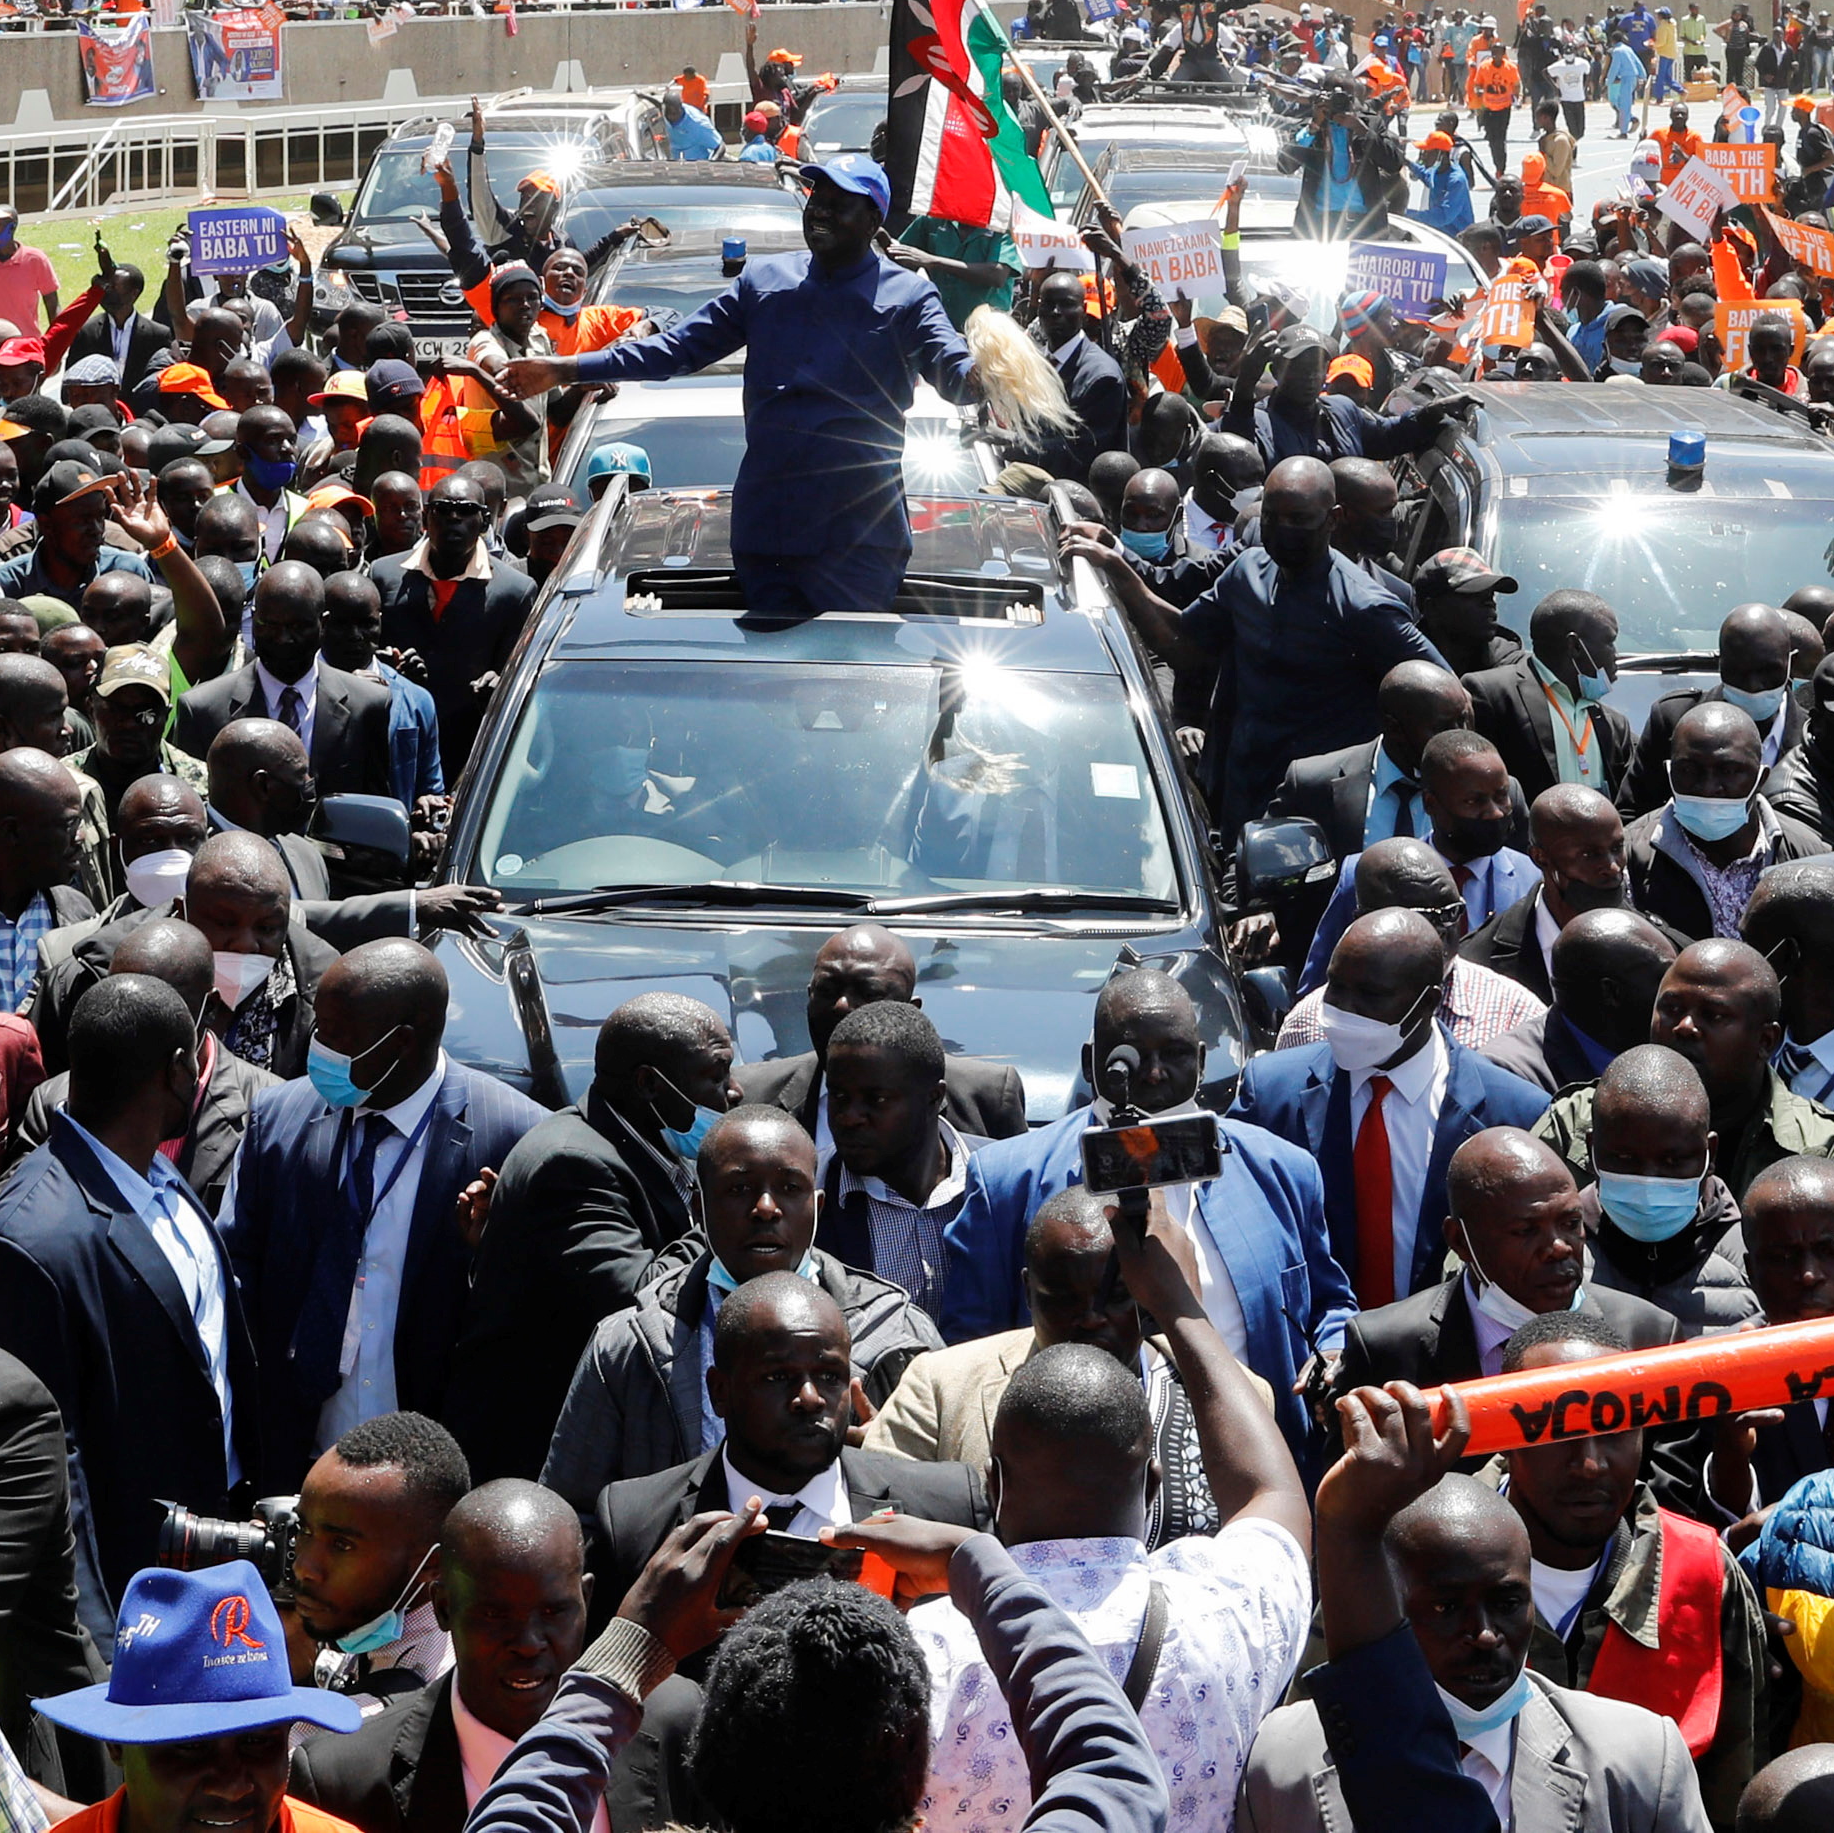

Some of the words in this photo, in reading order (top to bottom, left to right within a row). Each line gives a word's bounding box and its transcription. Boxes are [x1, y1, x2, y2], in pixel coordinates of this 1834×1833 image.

[1705, 149, 1735, 165] BABA
[1739, 150, 1764, 166] THE
[199, 218, 259, 239] EASTERN
[262, 217, 275, 234] NI
[1803, 229, 1826, 249] THE
[200, 236, 251, 261] BABA
[253, 234, 277, 256] TU
[1133, 231, 1213, 261] INAWEZEKANA
[1168, 251, 1218, 284] BABA
[1358, 253, 1416, 279] NAIROBI
[1420, 262, 1434, 281] NI
[1410, 279, 1434, 304] TU
[1507, 1379, 1733, 1444] UMOJA
[209, 1594, 265, 1649] R
